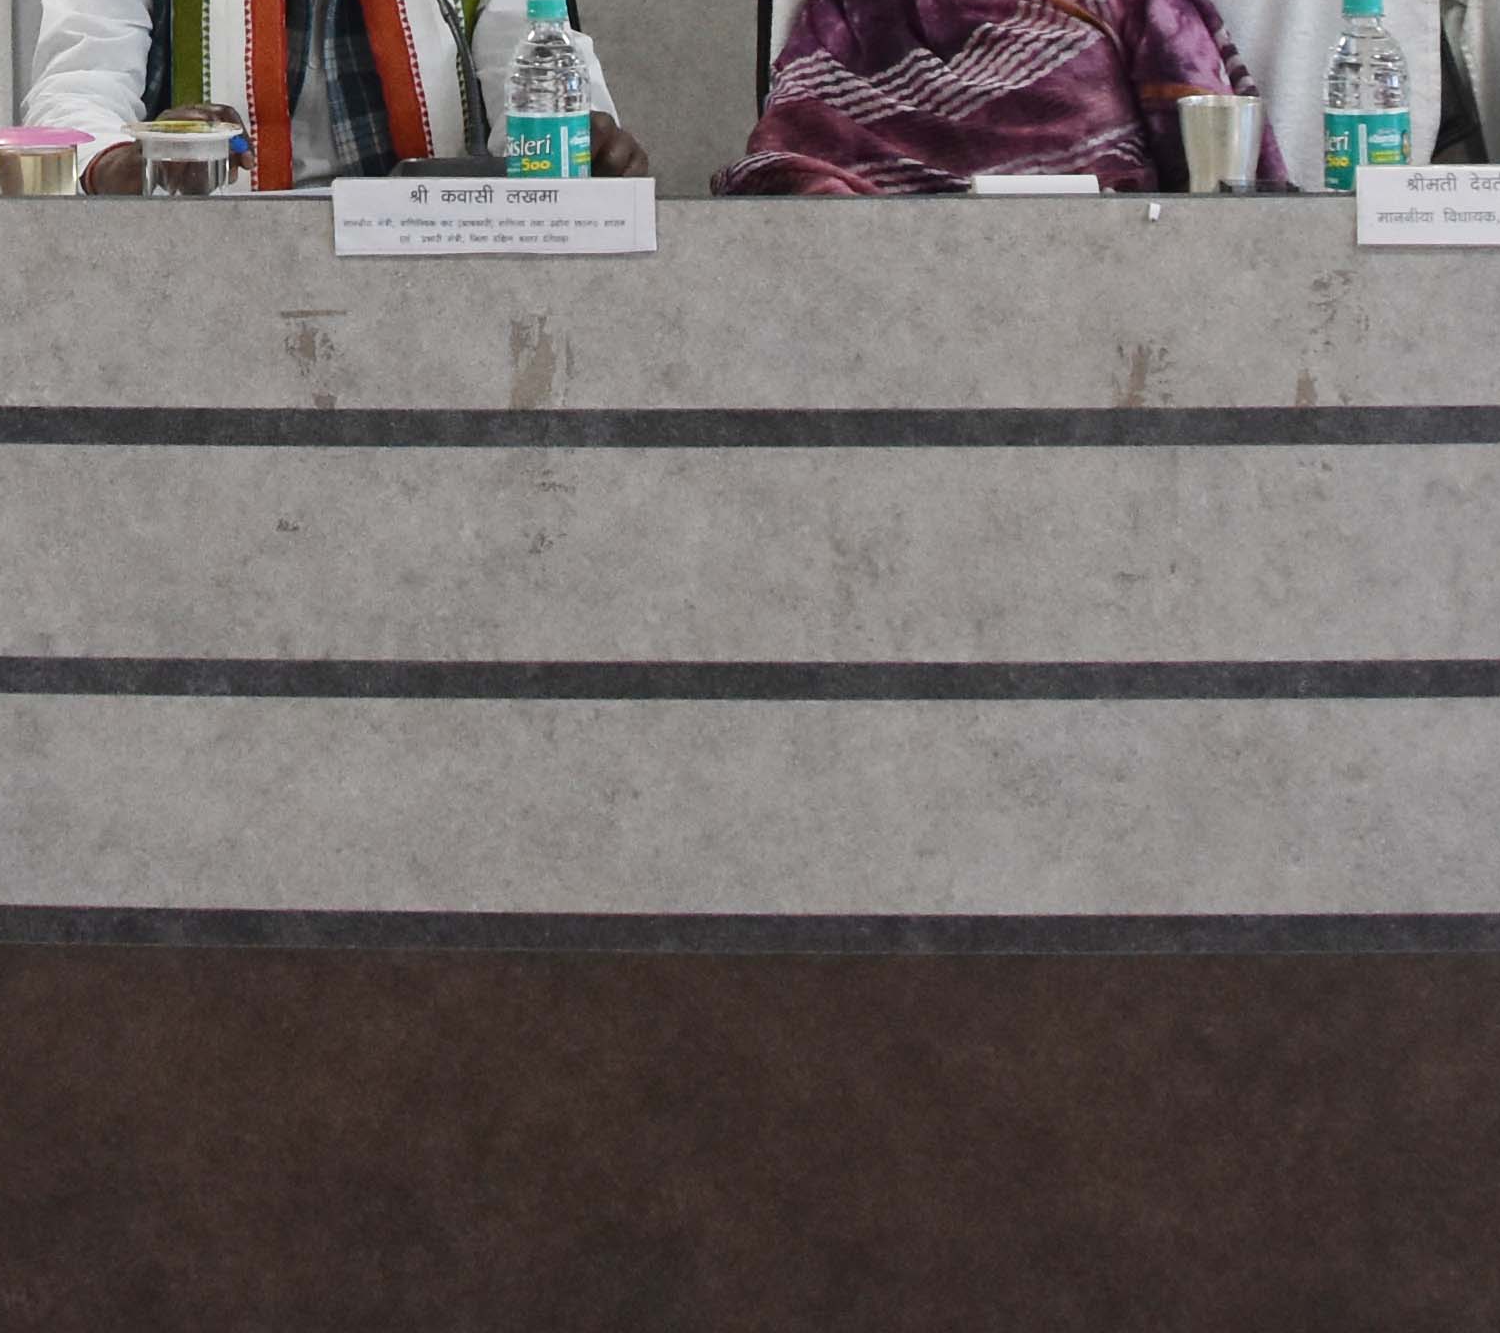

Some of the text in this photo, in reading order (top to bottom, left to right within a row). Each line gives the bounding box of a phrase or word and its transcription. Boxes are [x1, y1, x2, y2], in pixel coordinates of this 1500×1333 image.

[1407, 172, 1457, 191] श्रीमती
[410, 184, 559, 204] श्री कवासी लखमा
